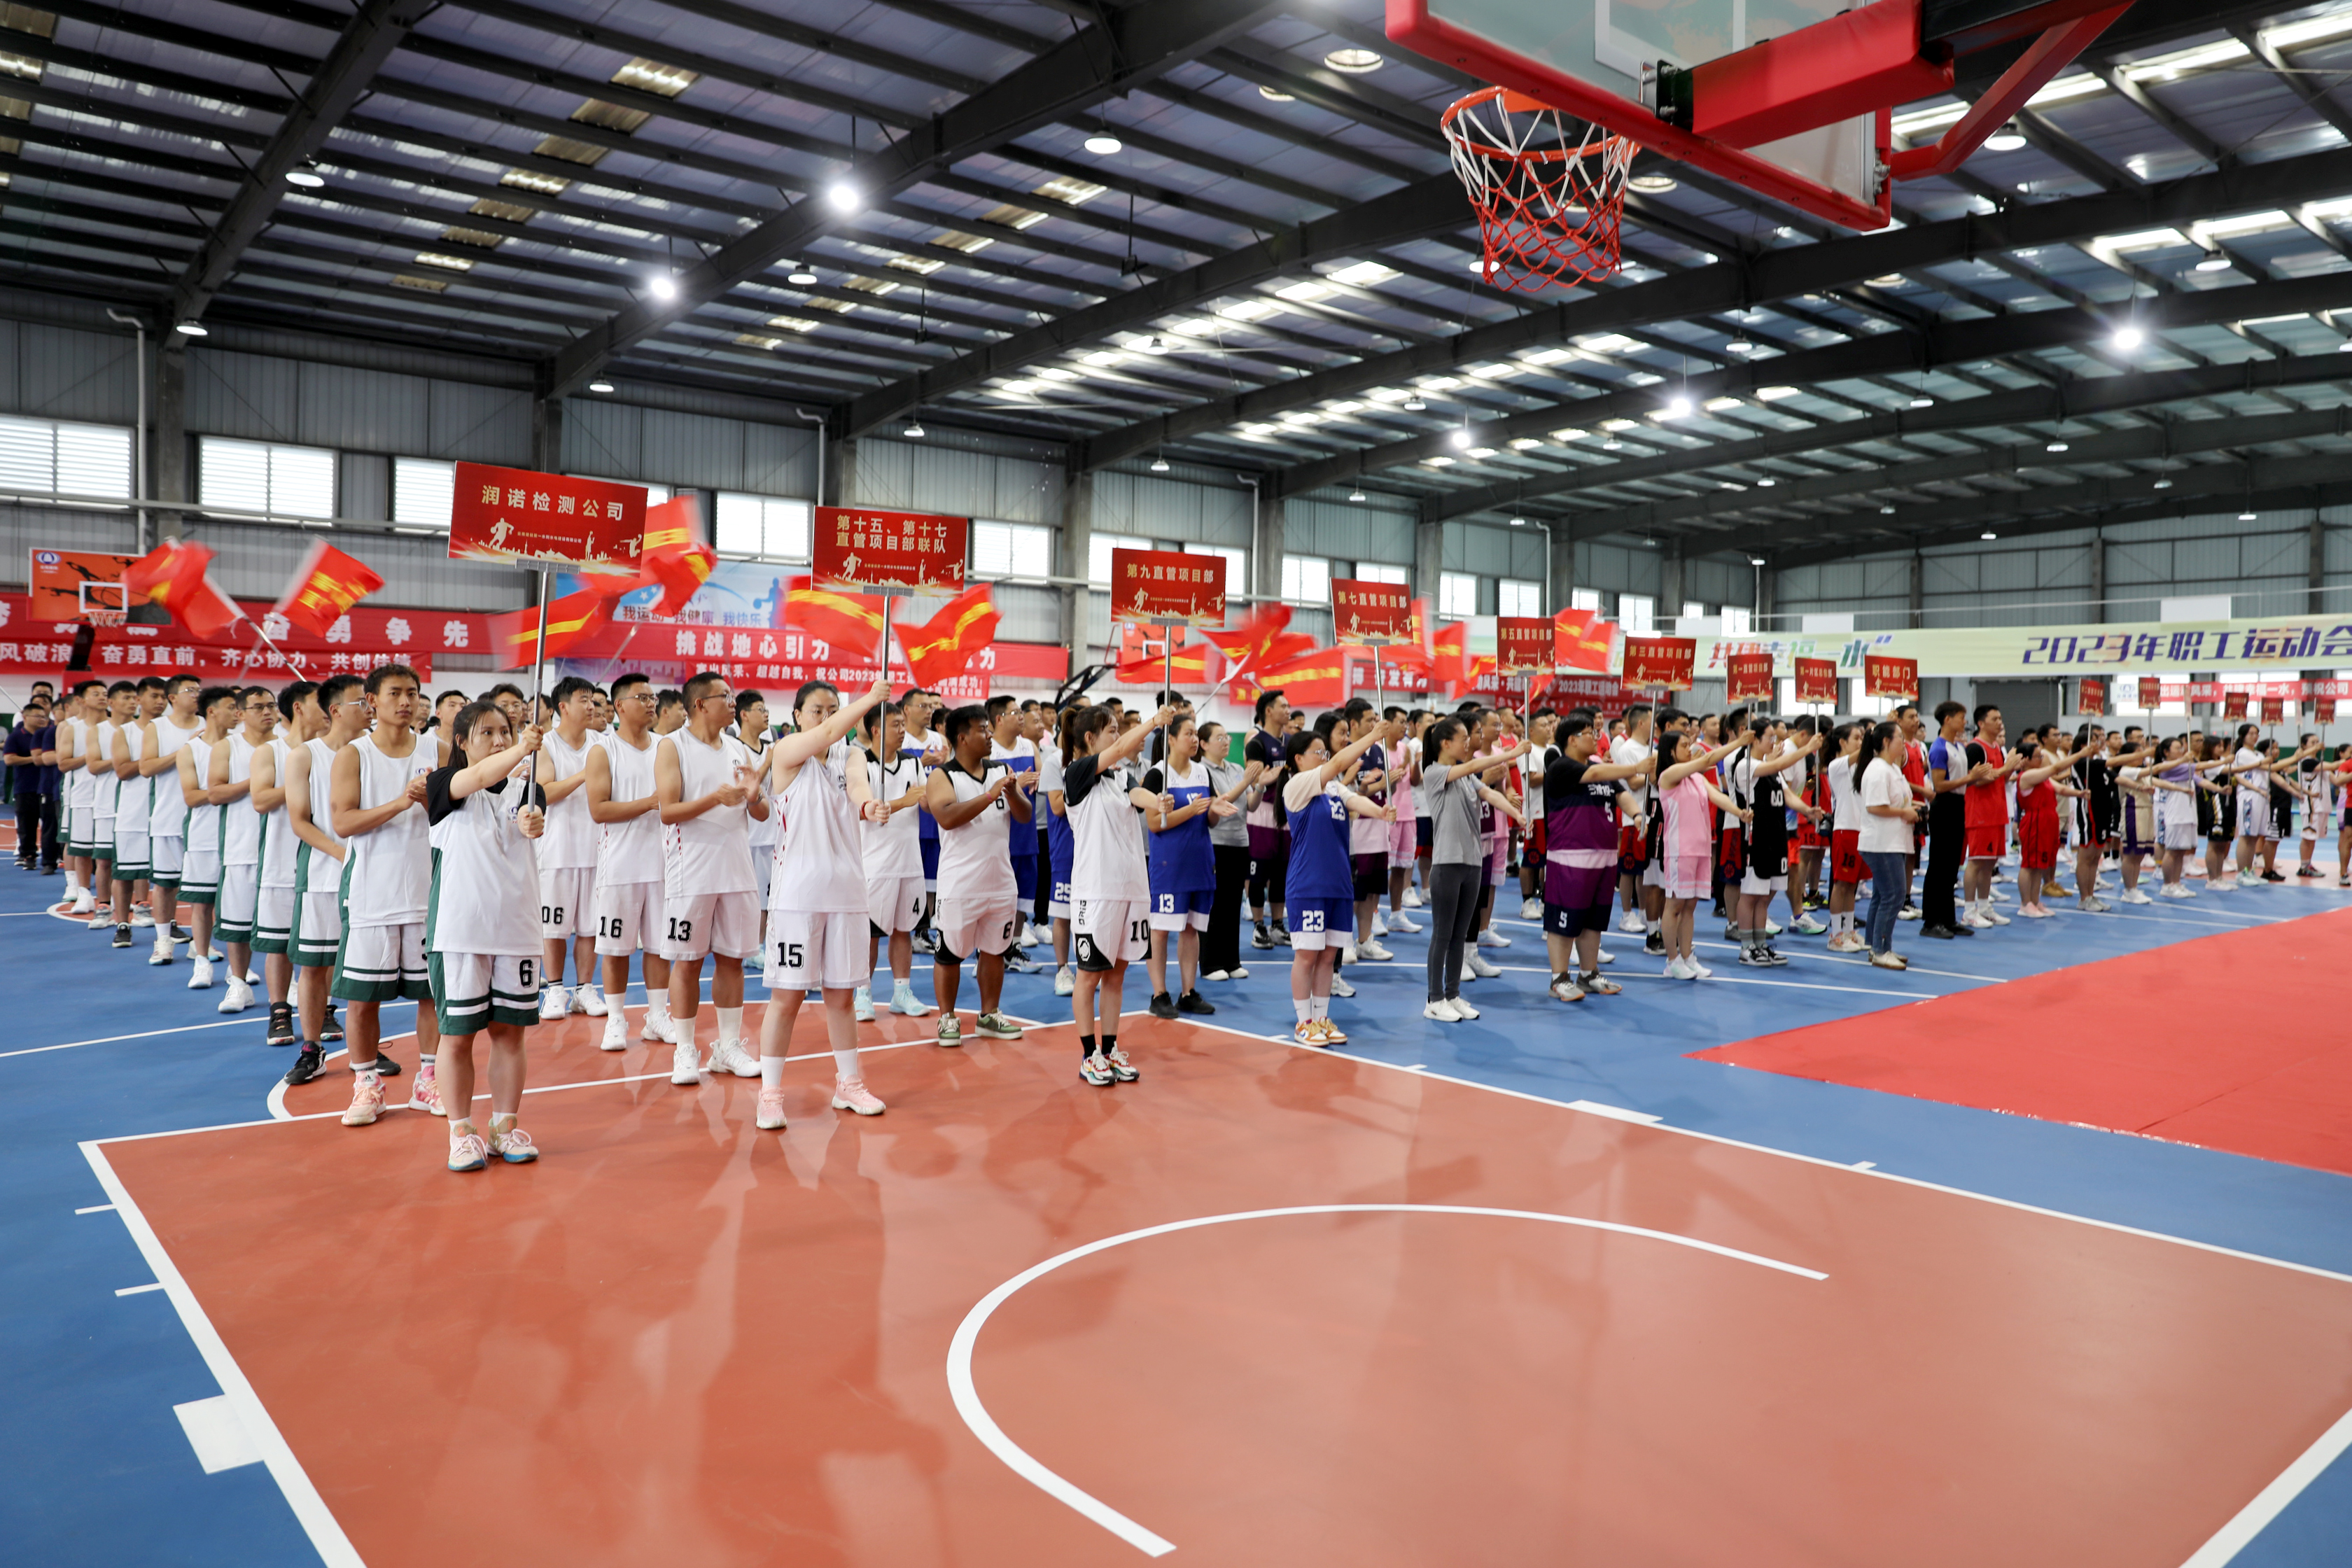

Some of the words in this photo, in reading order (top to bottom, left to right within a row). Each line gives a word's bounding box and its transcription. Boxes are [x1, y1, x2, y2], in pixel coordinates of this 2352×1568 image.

[482, 484, 623, 521] 润诺检测公司
[836, 514, 947, 538] 第十五、第十七
[836, 531, 946, 554] 直管项目部联队
[1127, 563, 1214, 584] 第九直管项目部
[1338, 591, 1407, 609] 第七直管项目部
[723, 611, 762, 627] 我快乐
[1501, 627, 1553, 641] 第五直管项目部
[2022, 625, 2352, 664] 2023年职工运动会
[676, 629, 830, 662] 挑战地心引力
[1630, 645, 1692, 660] 第三直管项目部
[1872, 664, 1910, 680] 职能部门
[1329, 799, 1346, 821] 23
[1842, 852, 1856, 869] 18
[1054, 881, 1071, 902] 25
[912, 897, 920, 916] 4
[1158, 893, 1174, 913] 13
[542, 906, 564, 925] 06
[1302, 909, 1324, 932] 23
[1558, 911, 1567, 929] 5
[598, 916, 624, 939] 16
[667, 917, 692, 942] 13
[1130, 918, 1149, 943] 10
[777, 941, 804, 969] 15
[519, 958, 533, 988] 6
